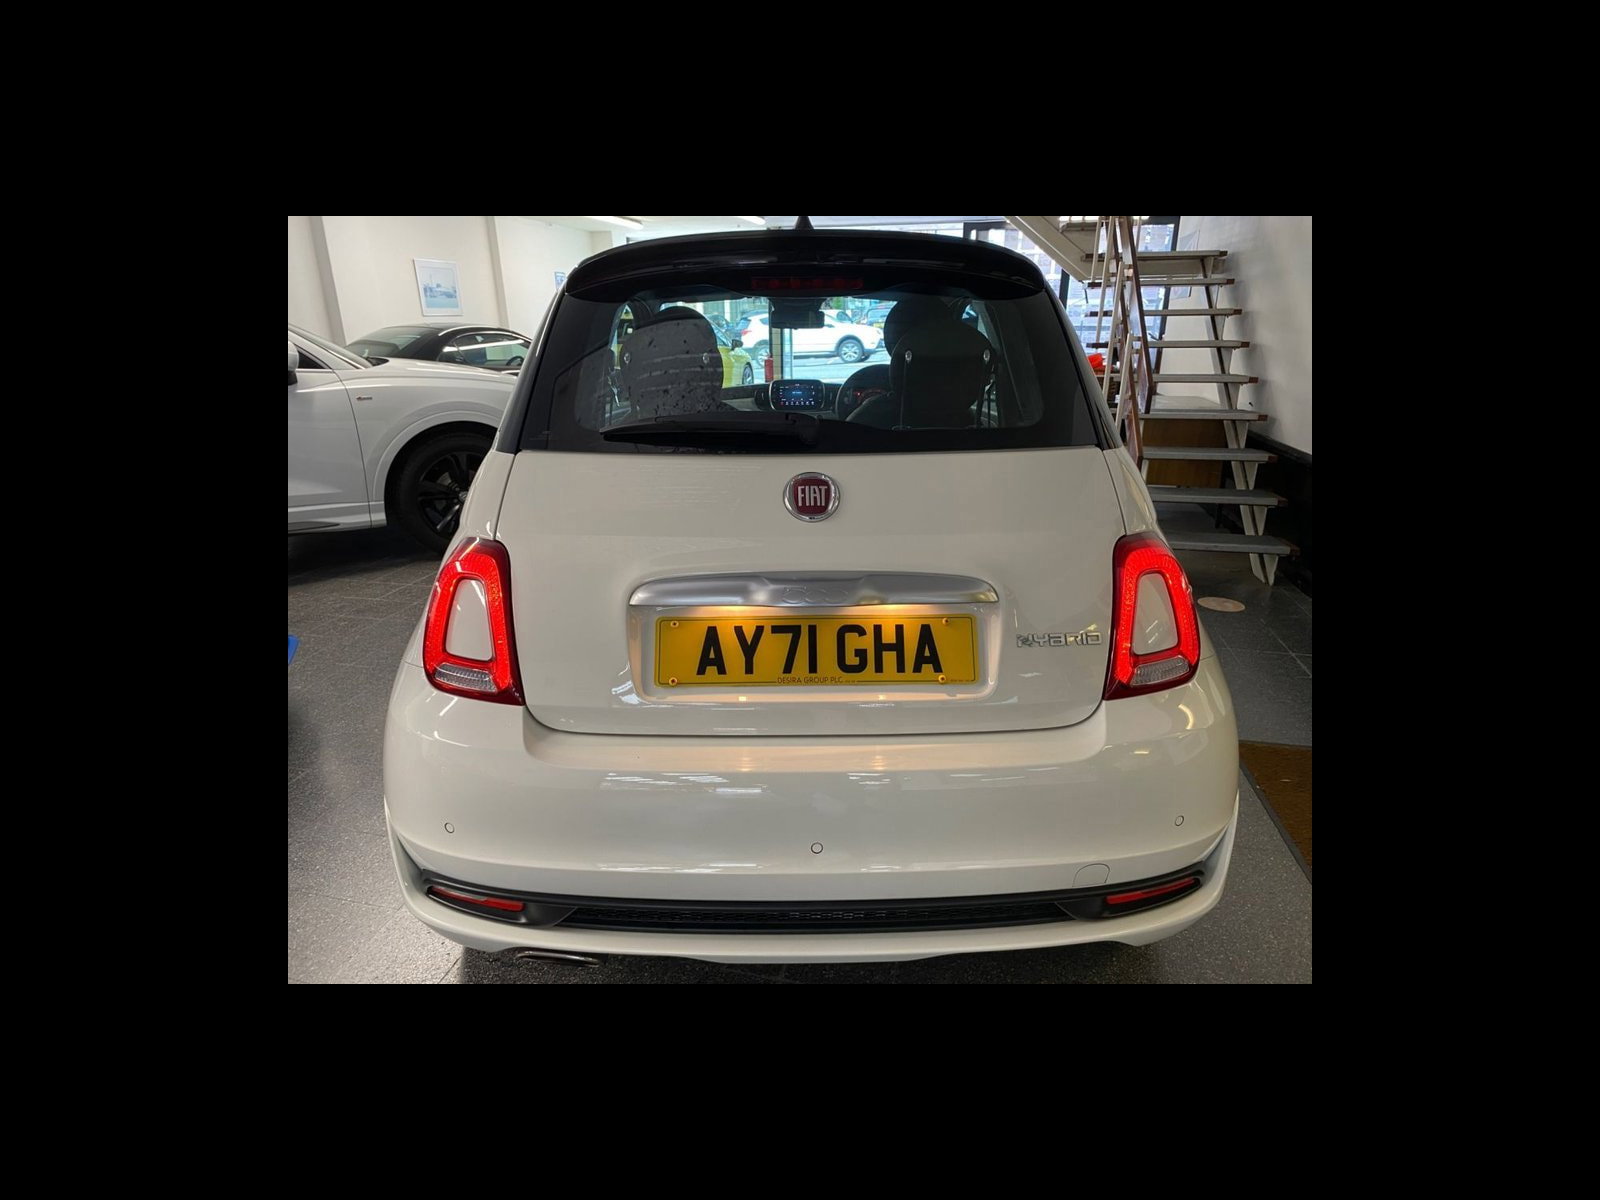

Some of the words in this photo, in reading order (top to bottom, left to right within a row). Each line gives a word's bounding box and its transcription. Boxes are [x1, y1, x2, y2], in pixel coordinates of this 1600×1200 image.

[797, 485, 828, 507] FIAT
[696, 624, 818, 675] AY71
[836, 624, 943, 674] GHA
[1016, 632, 1102, 648] HYBRID
[803, 676, 829, 684] GROUP
[830, 676, 843, 684] PLC
